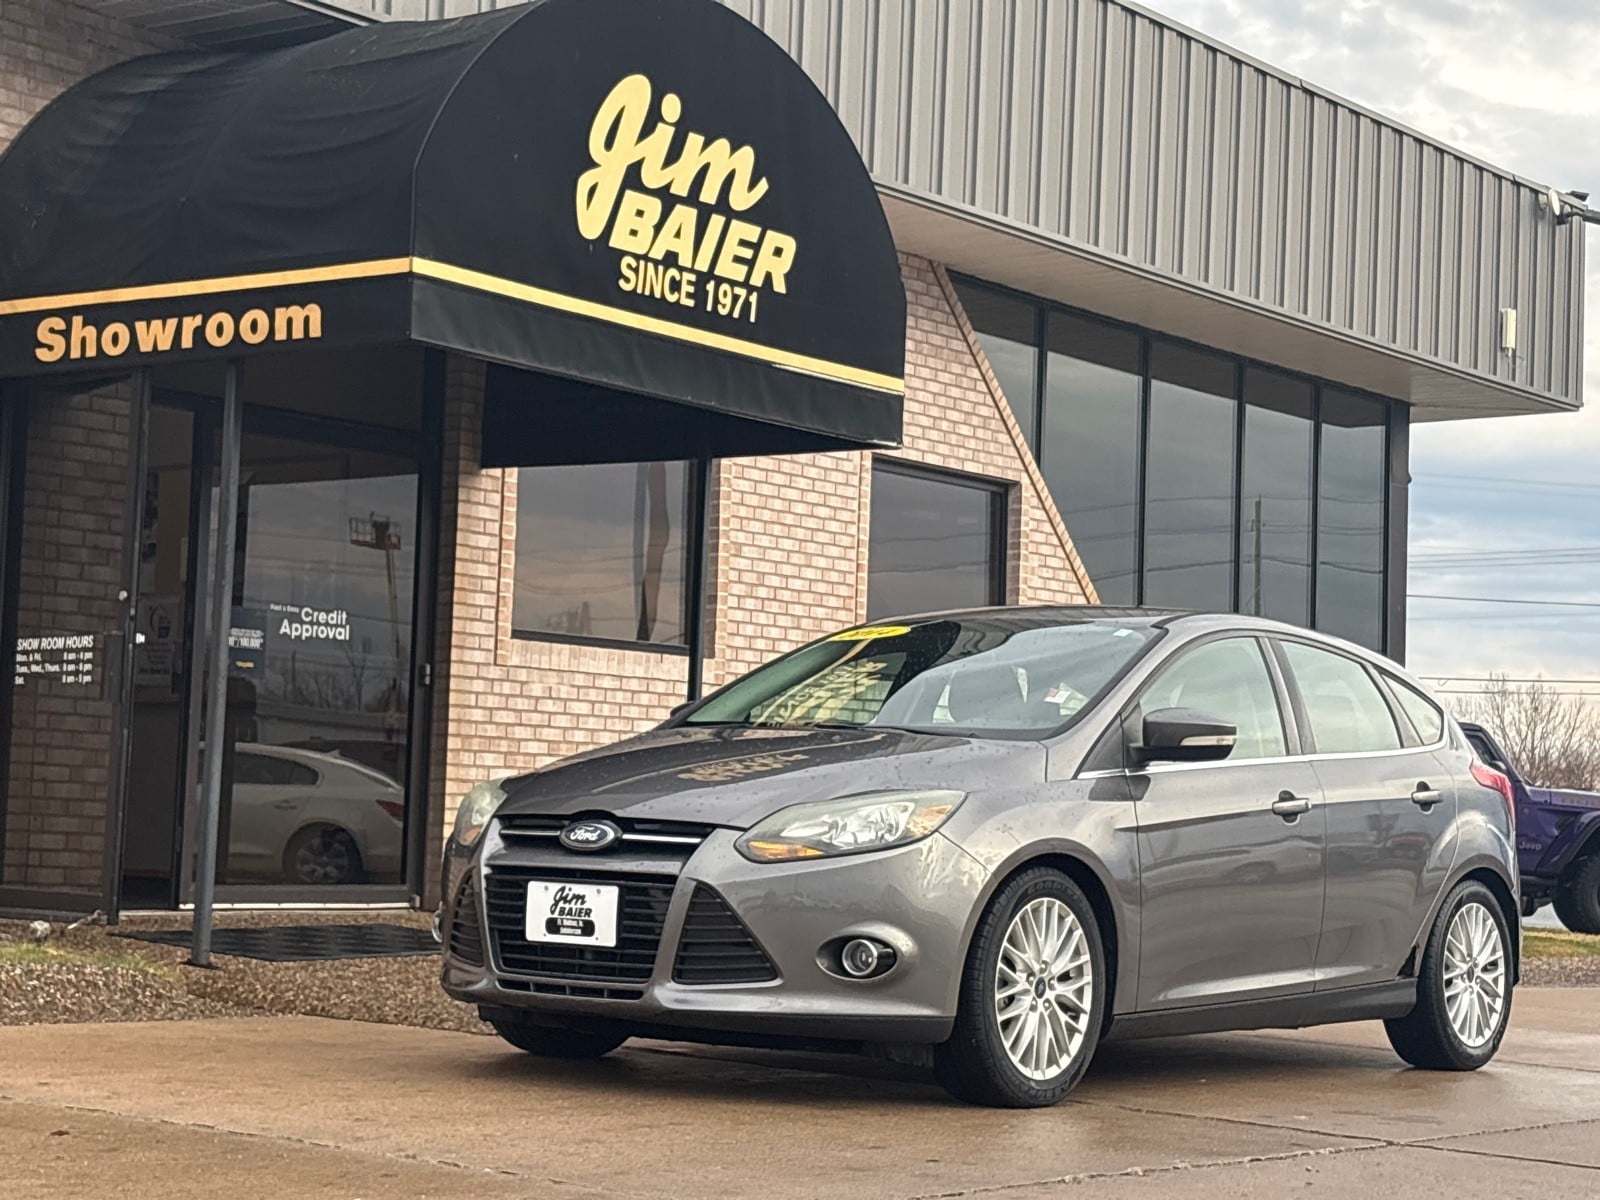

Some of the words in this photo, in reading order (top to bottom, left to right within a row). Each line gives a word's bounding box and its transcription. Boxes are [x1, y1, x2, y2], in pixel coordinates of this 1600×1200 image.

[576, 74, 769, 240] Jim
[608, 189, 796, 294] BAIER
[618, 255, 697, 307] SINCE
[706, 280, 758, 323] 1971
[35, 303, 322, 363] Showroom
[301, 607, 347, 625] Credit
[279, 618, 350, 641] Approval
[17, 638, 40, 651] SHOW
[41, 637, 65, 650] ROOM
[65, 635, 94, 649] HOURS
[570, 825, 601, 841] Ford
[1519, 841, 1542, 851] Jeep
[550, 885, 587, 916] Jim
[558, 906, 592, 919] BAIER
